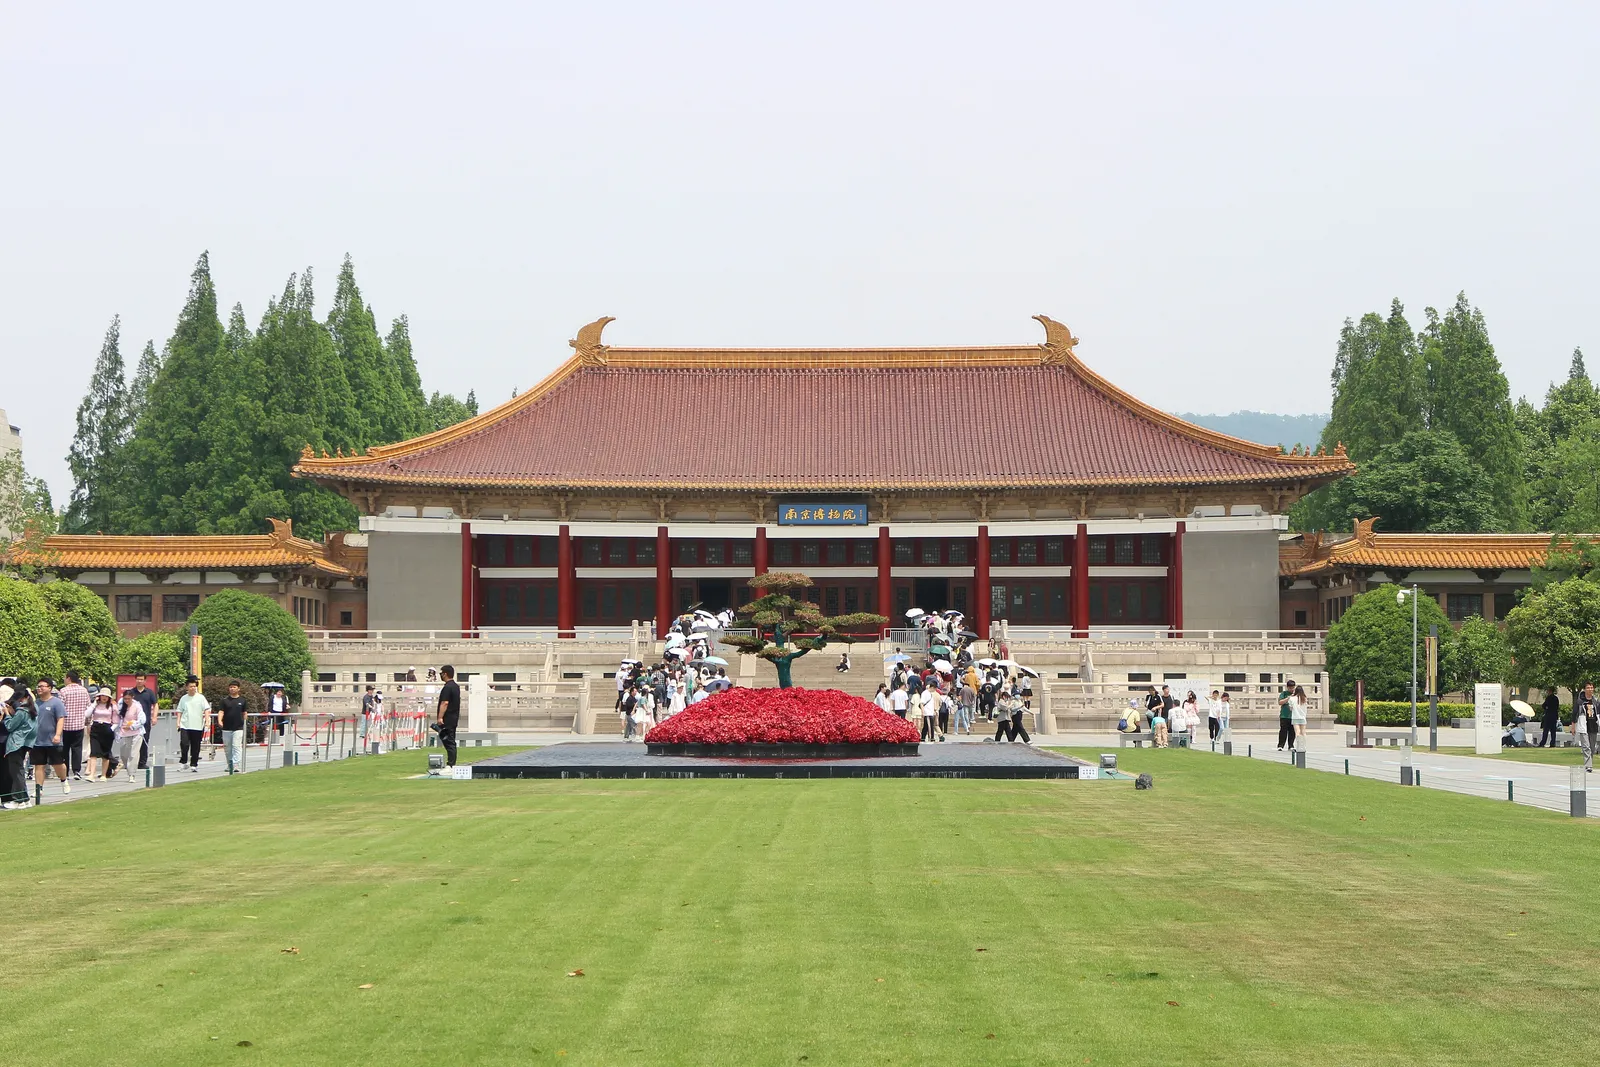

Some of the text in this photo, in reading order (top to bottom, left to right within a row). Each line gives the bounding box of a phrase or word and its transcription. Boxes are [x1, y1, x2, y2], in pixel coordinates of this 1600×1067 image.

[785, 508, 857, 520] 南京博物院
